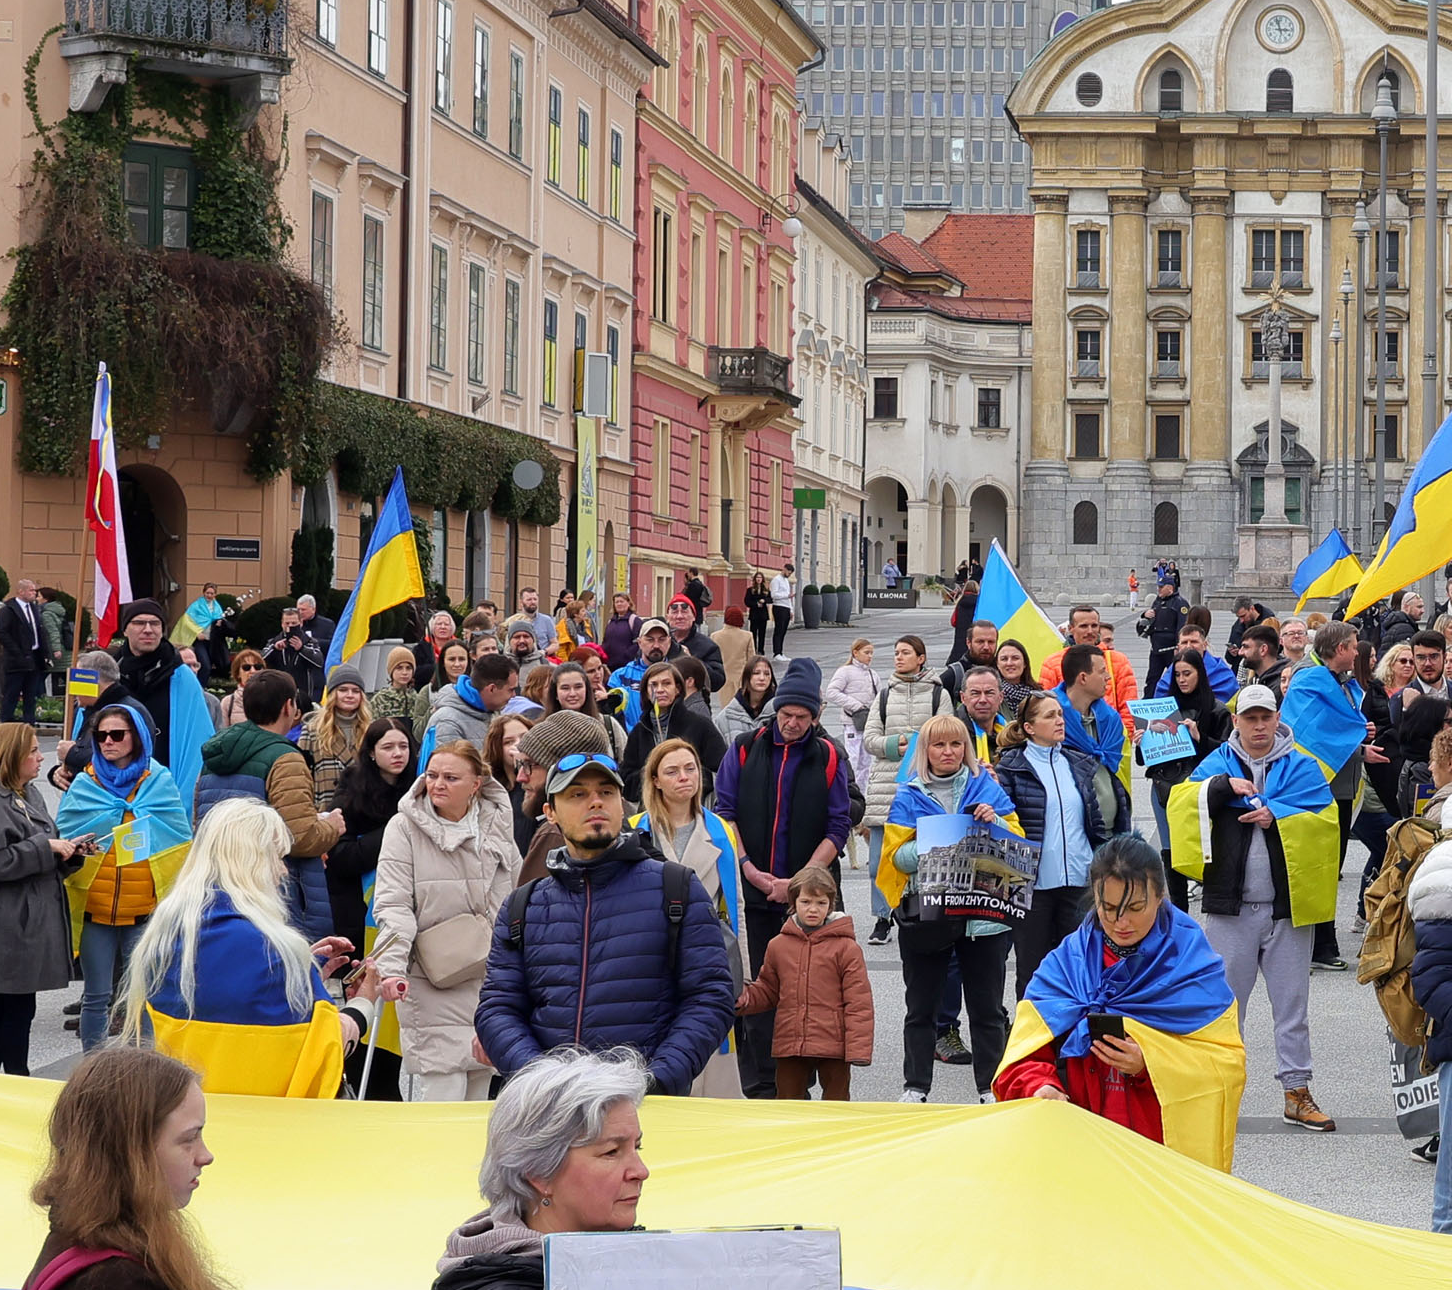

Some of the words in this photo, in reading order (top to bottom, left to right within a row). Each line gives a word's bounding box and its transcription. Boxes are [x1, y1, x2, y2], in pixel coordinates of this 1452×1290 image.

[1132, 707, 1150, 715] WITH
[1145, 752, 1161, 761] MASS
[923, 895, 942, 906] I'M
[944, 895, 965, 906] FROM
[965, 895, 1026, 919] ZHYTOMYR
